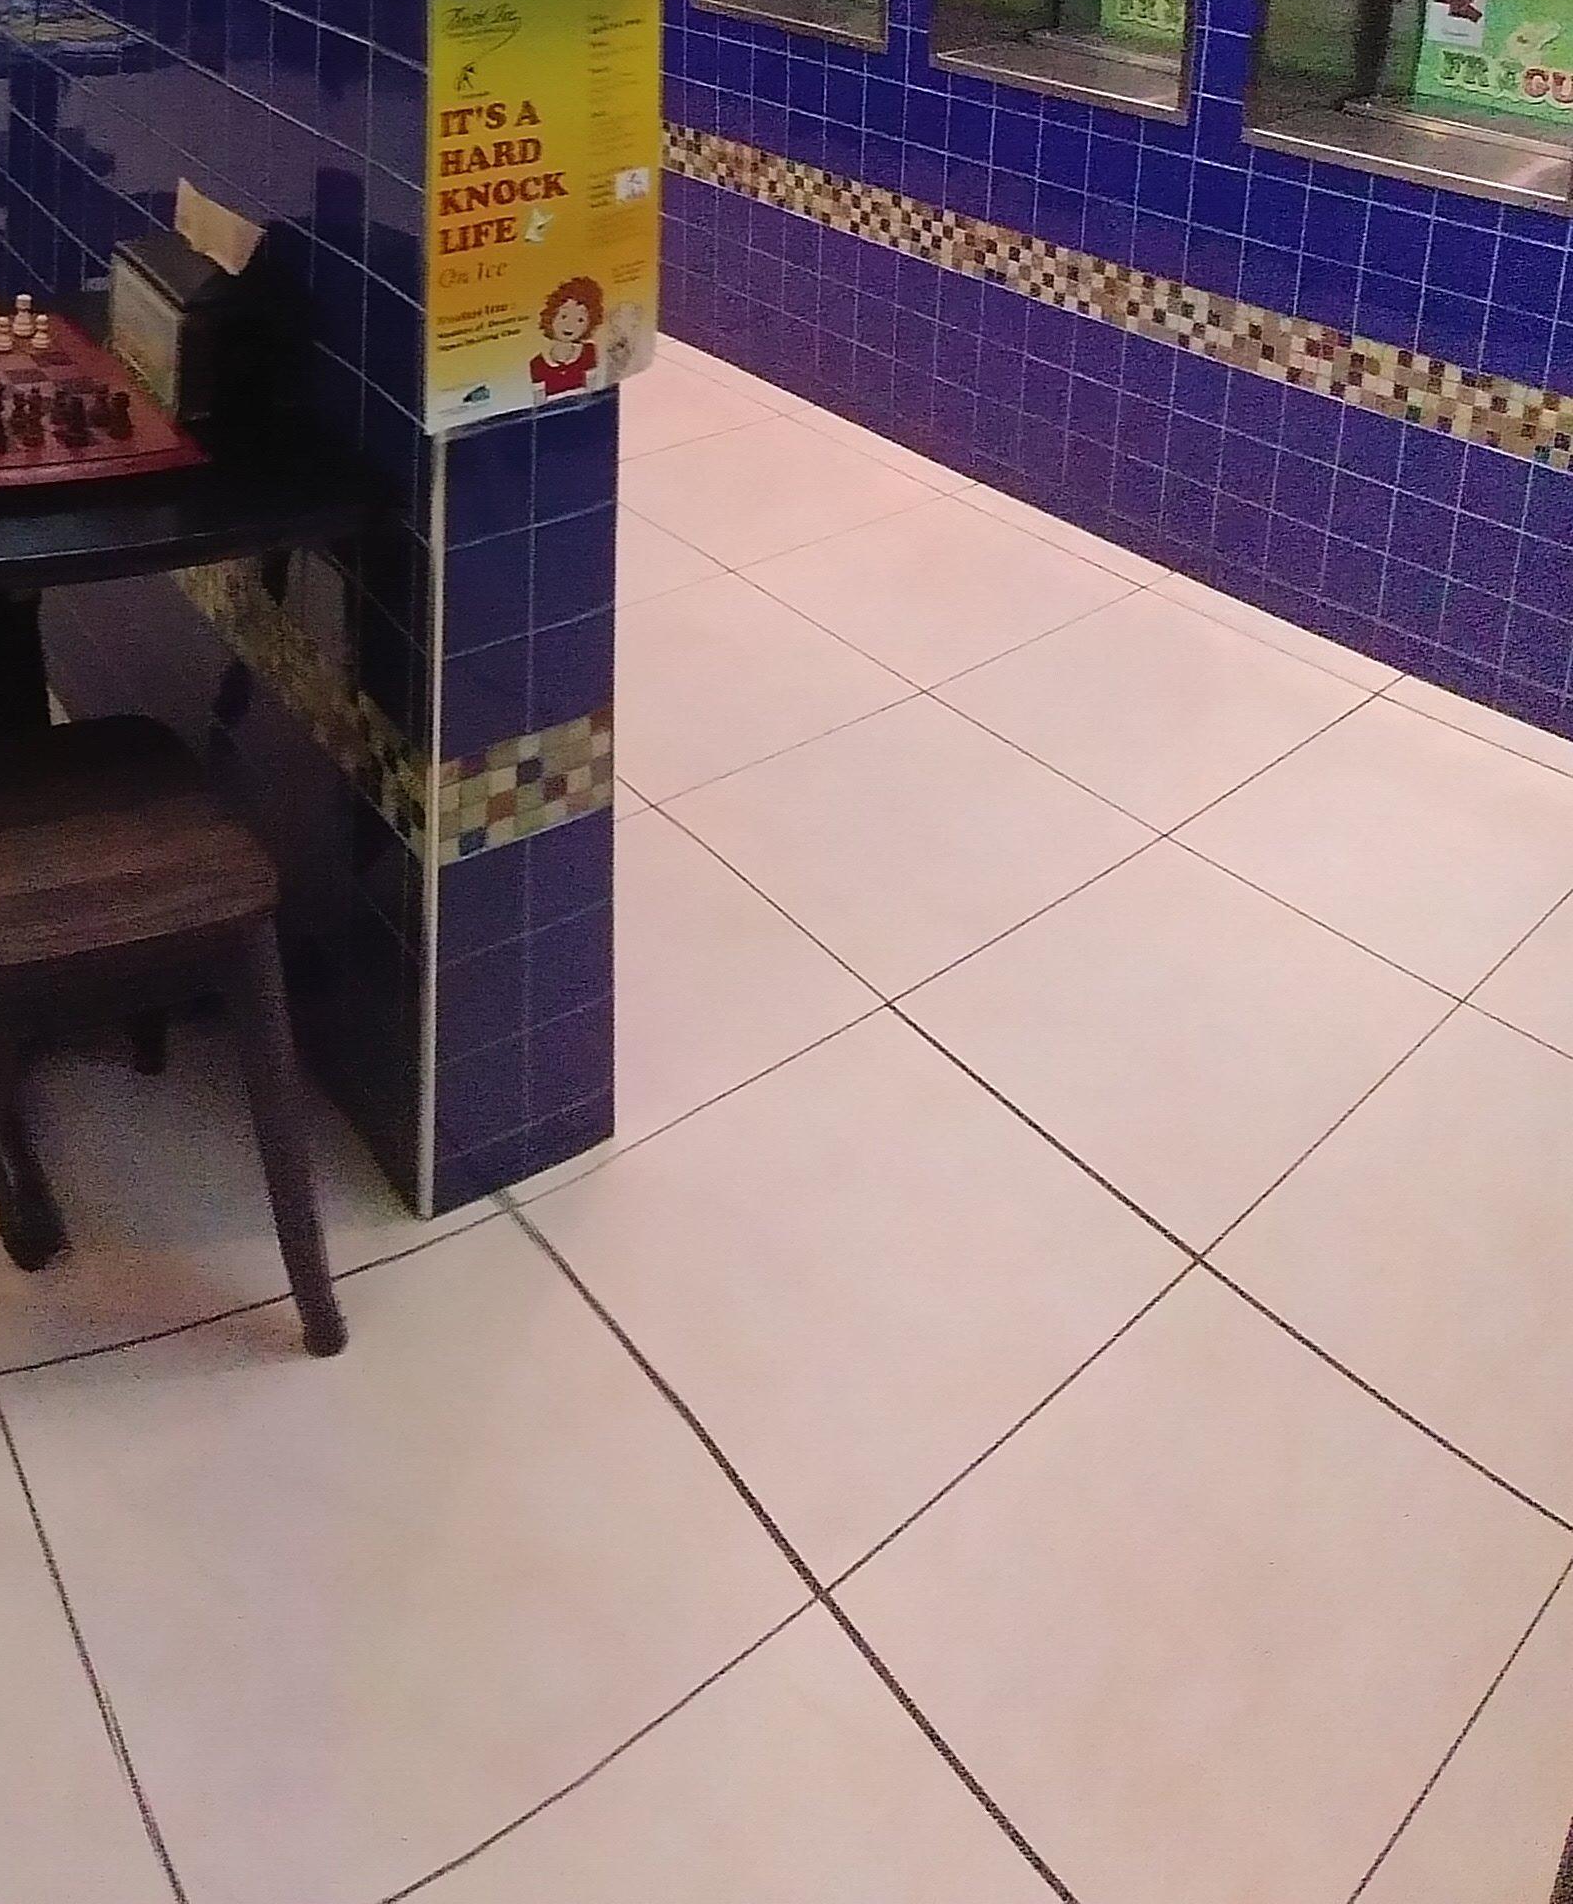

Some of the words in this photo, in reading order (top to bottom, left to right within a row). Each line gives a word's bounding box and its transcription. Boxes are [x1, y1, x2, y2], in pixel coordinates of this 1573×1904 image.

[440, 102, 507, 138] IT'S
[515, 101, 541, 127] A
[439, 138, 542, 177] HARD
[437, 171, 569, 216] KNOCK
[438, 217, 518, 255] LIFE
